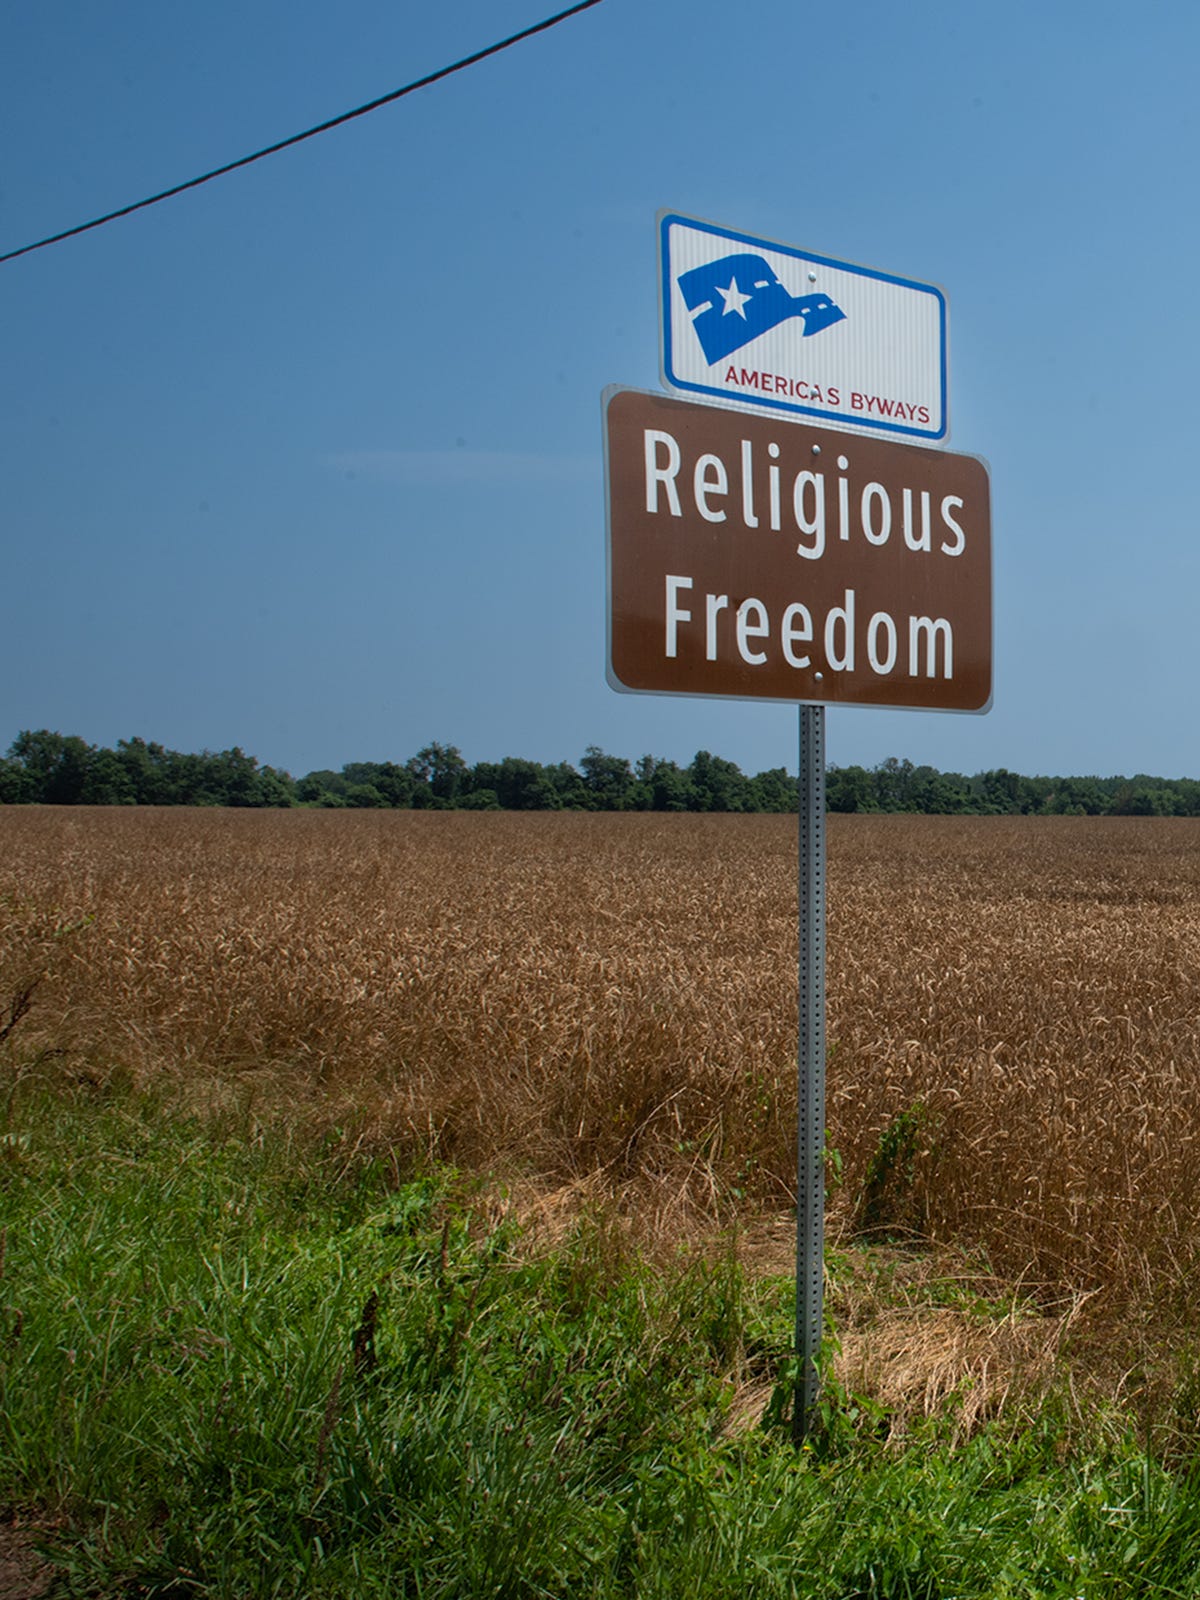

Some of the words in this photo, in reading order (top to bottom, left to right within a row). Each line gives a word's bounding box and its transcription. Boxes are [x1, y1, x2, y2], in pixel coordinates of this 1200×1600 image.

[851, 392, 930, 423] BYWAYS
[644, 429, 966, 560] Religious
[665, 575, 953, 680] Freedom
